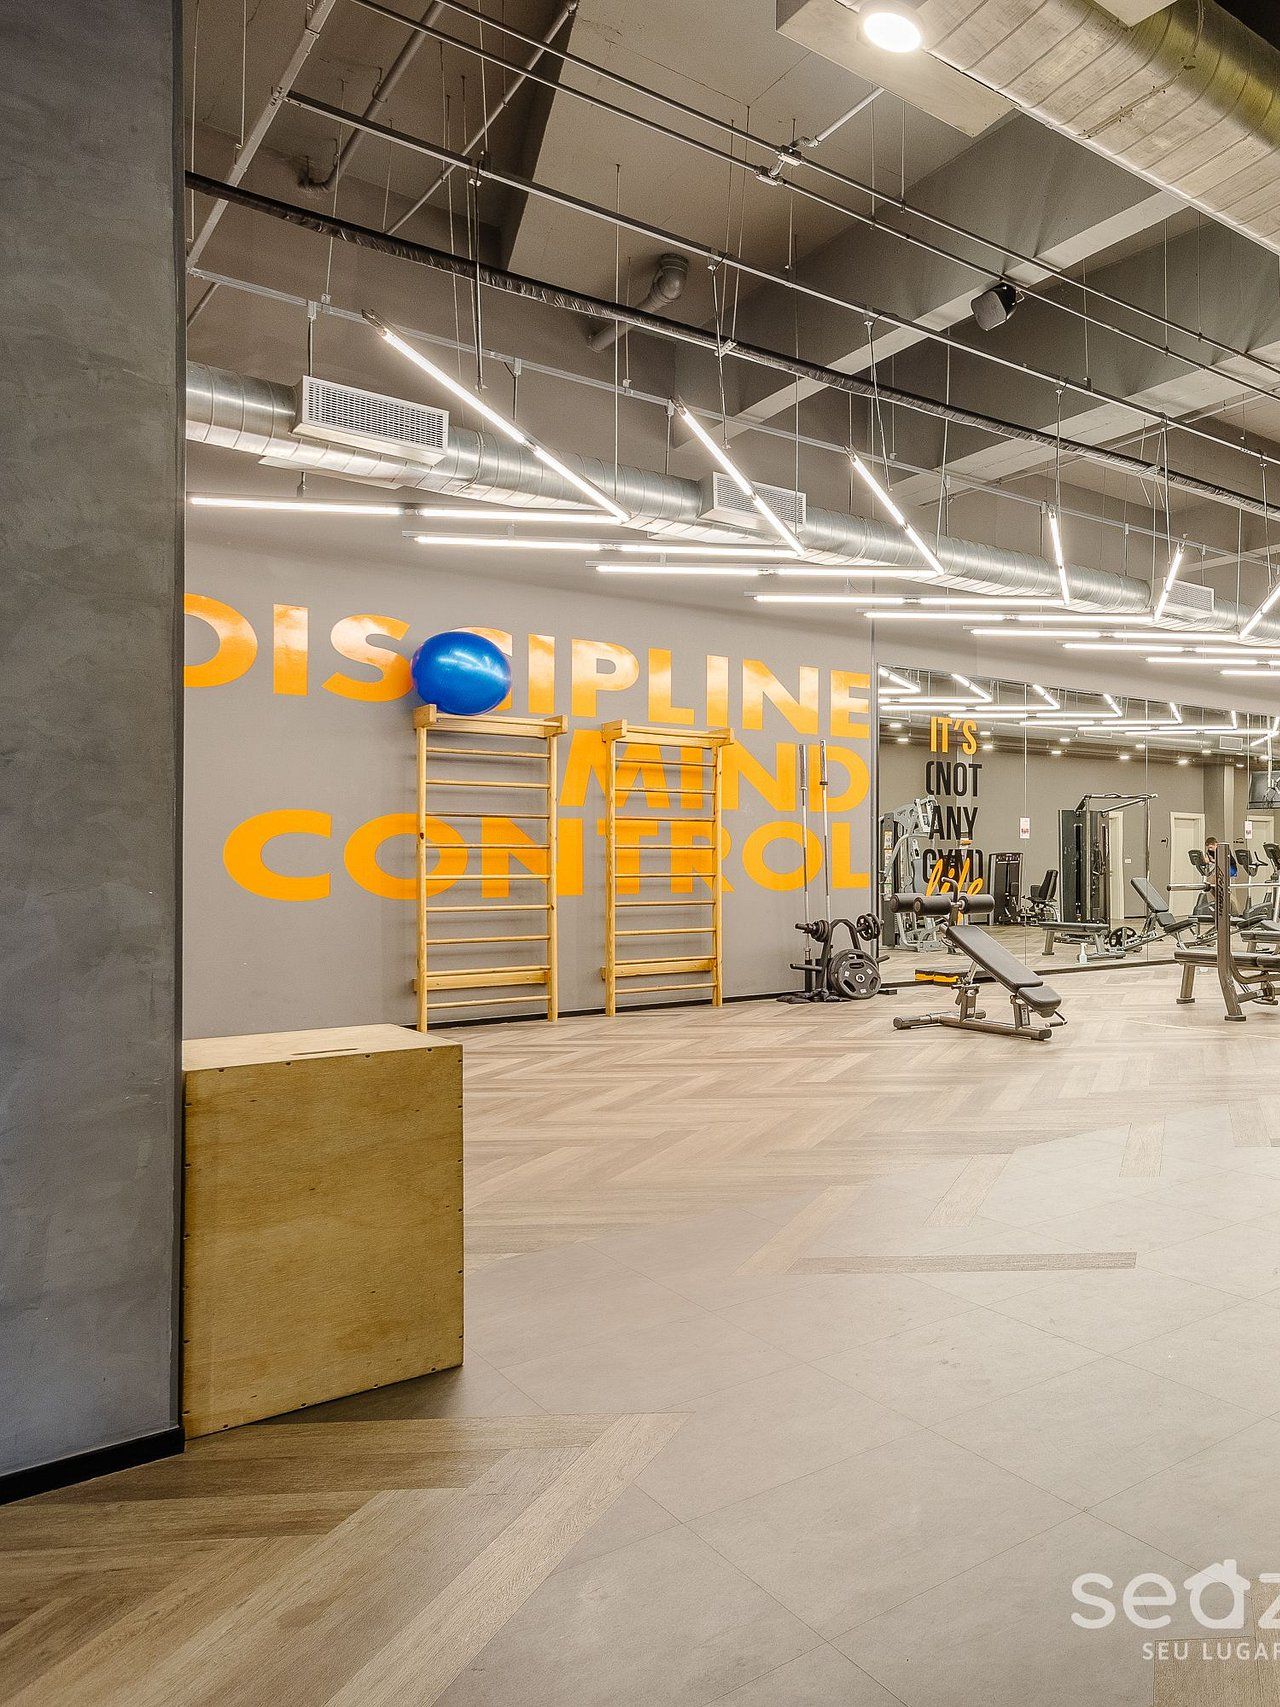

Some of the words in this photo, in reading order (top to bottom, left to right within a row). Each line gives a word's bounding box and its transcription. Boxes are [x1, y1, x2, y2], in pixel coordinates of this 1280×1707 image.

[184, 592, 870, 739] DISIPLINE
[930, 716, 979, 755] IT'S
[558, 728, 870, 813] MIND
[925, 760, 983, 798] (NOT
[928, 805, 979, 841] ANY
[222, 808, 870, 902] CONTROL
